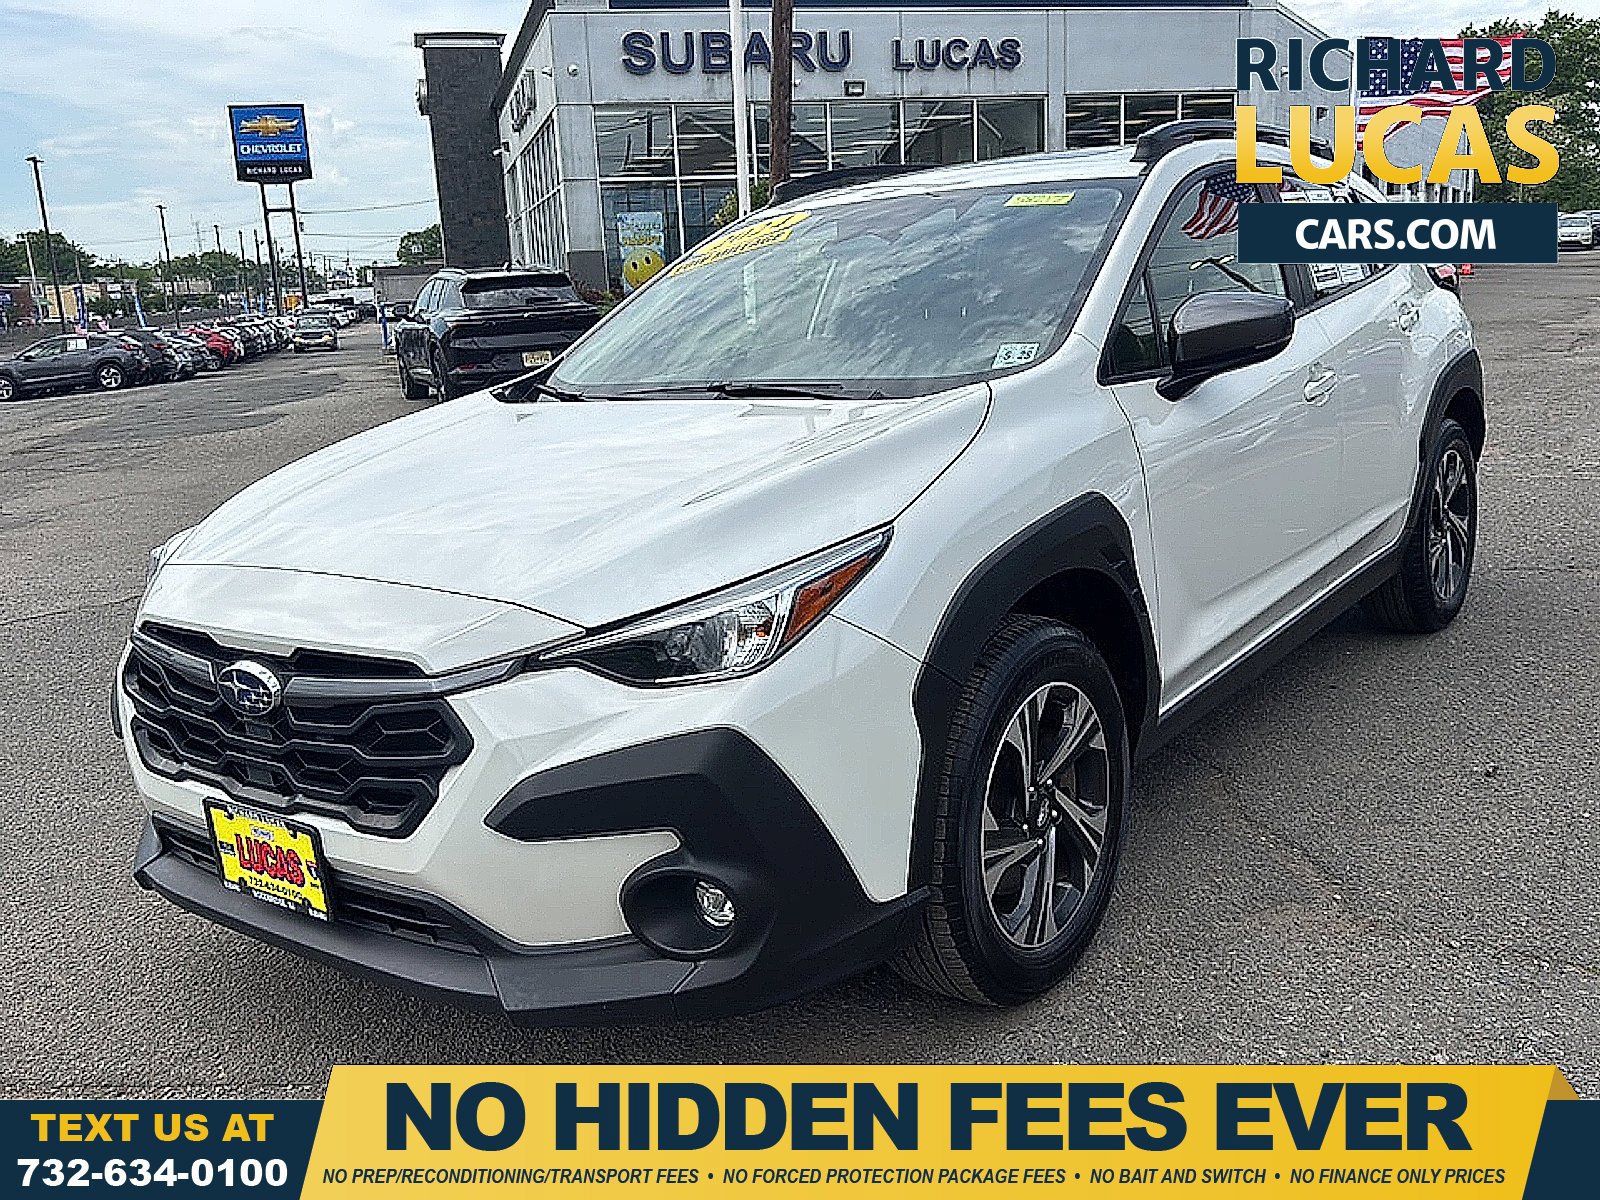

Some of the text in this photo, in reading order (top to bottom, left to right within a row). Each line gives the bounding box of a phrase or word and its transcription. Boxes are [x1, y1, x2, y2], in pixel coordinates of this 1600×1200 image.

[621, 30, 1023, 76] SUBARU LUCAS
[240, 143, 303, 155] CHEVROLET
[234, 833, 306, 888] LUCAS
